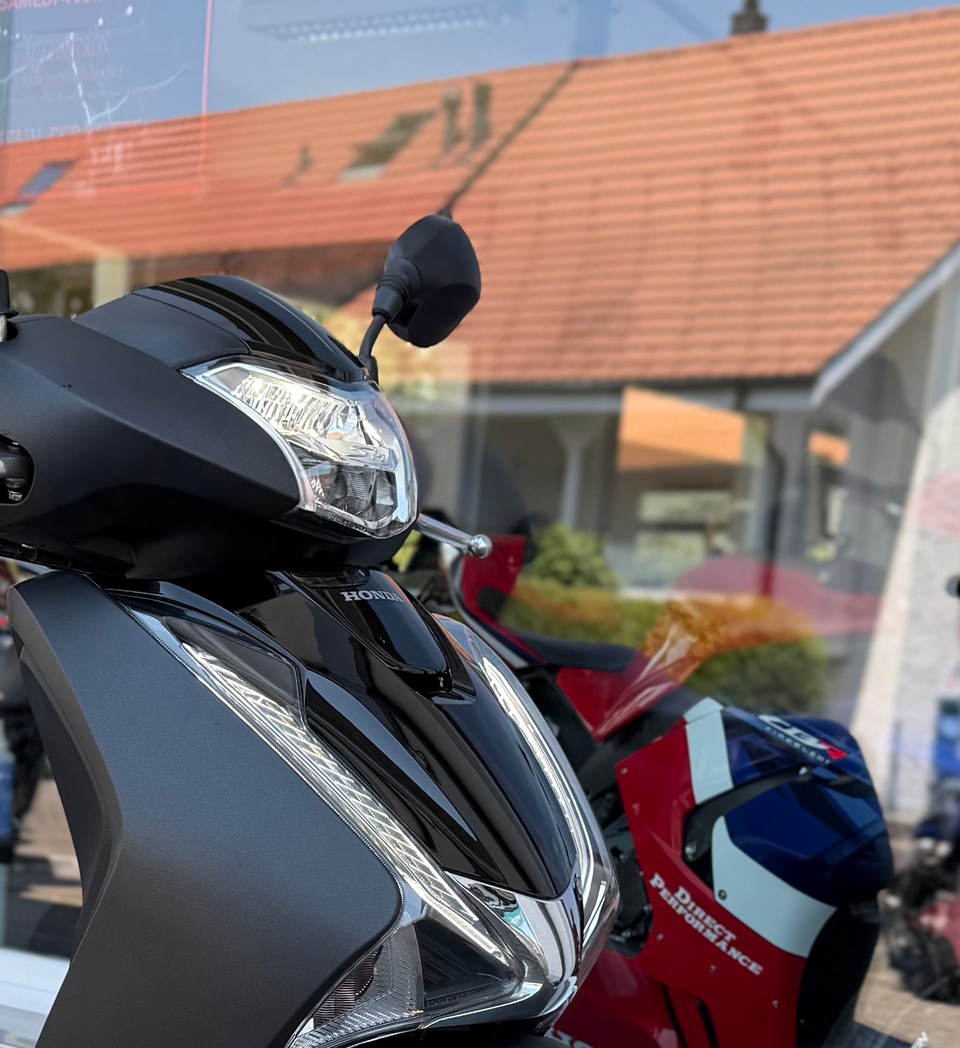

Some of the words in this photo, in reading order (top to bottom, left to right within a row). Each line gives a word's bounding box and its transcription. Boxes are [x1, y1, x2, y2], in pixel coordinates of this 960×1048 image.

[341, 590, 404, 603] HONDA
[649, 871, 765, 976] PERFORMANCE
[674, 885, 737, 944] DIRECT
